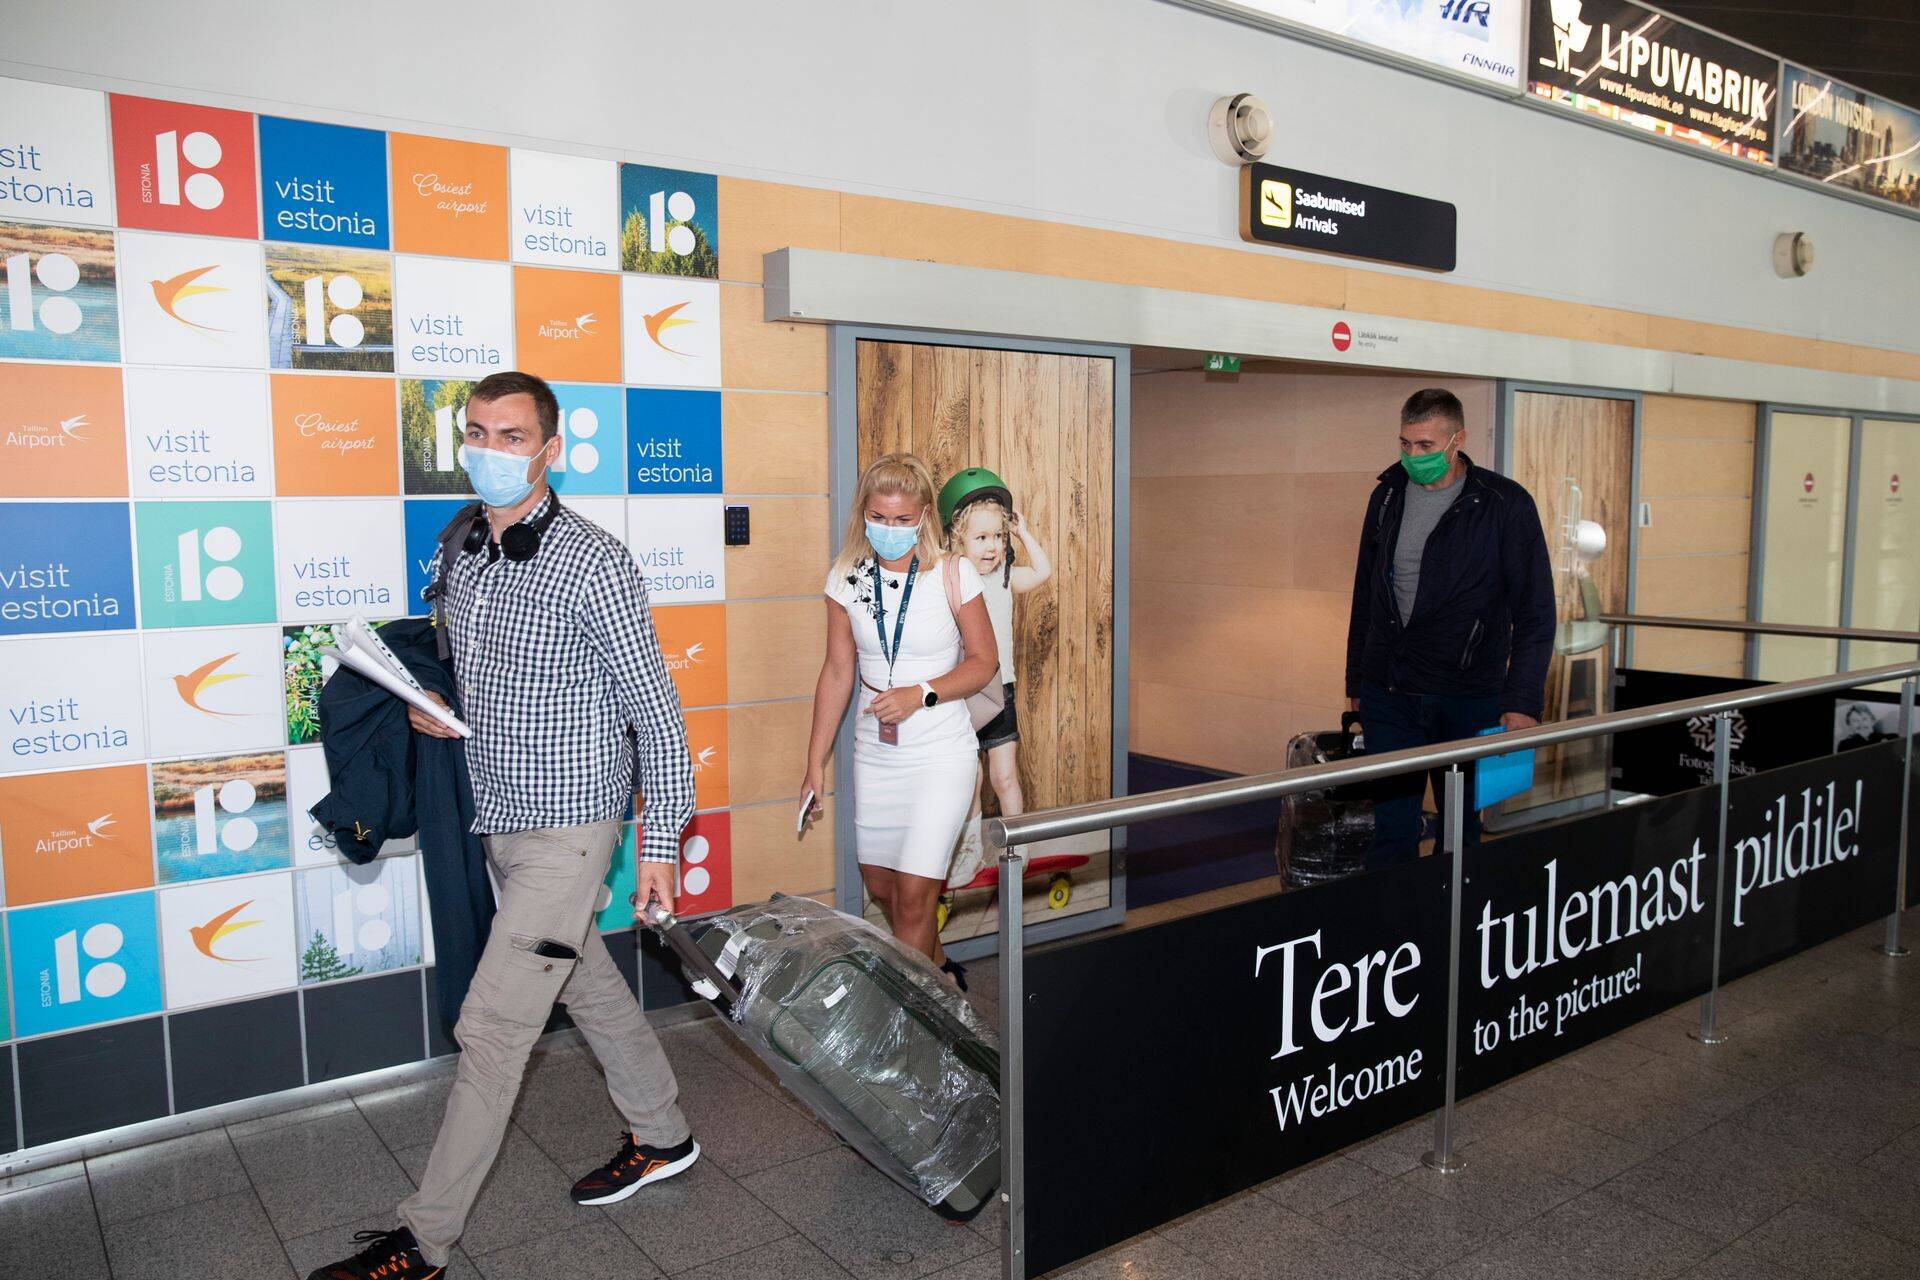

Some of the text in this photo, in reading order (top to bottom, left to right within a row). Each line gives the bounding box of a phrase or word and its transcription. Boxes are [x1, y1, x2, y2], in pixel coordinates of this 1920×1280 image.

[1462, 53, 1515, 77] FINNAIR
[1601, 23, 1769, 122] LIPUVABRIK
[0, 145, 41, 171] sit
[0, 176, 93, 208] stonia
[142, 163, 152, 204] ESTONIA
[275, 177, 335, 204] visit
[412, 173, 472, 197] Cosiest
[437, 200, 488, 219] airport
[1295, 188, 1366, 217] Saabumised
[277, 207, 375, 235] estonia
[524, 204, 573, 228] visit
[1295, 213, 1339, 236] Arrivals
[524, 231, 606, 257] estonia
[292, 307, 301, 344] ESTONIA
[410, 314, 463, 337] visit
[539, 324, 580, 339] Airport
[411, 342, 500, 365] estonia
[294, 413, 358, 438] Cosiest
[6, 431, 66, 449] Airport
[147, 430, 210, 453] visit
[321, 435, 375, 456] airport
[637, 437, 682, 458] visit
[424, 437, 432, 472] ESTONIA
[149, 459, 256, 483] estonia
[637, 462, 713, 483] estonia
[293, 555, 350, 579] visit
[640, 547, 684, 567] visit
[0, 563, 70, 589] visit
[166, 563, 175, 602] ESTONIA
[642, 570, 715, 592] estonia
[2, 593, 119, 620] estonia
[295, 583, 390, 608] estonia
[9, 698, 80, 725] visit
[12, 726, 128, 756] estonia
[35, 833, 93, 854] Airport
[1255, 780, 1864, 1061] Tere tulemast pildile!
[41, 968, 52, 1008] ESTONIA
[1270, 952, 1643, 1132] Welcome to the picture!
